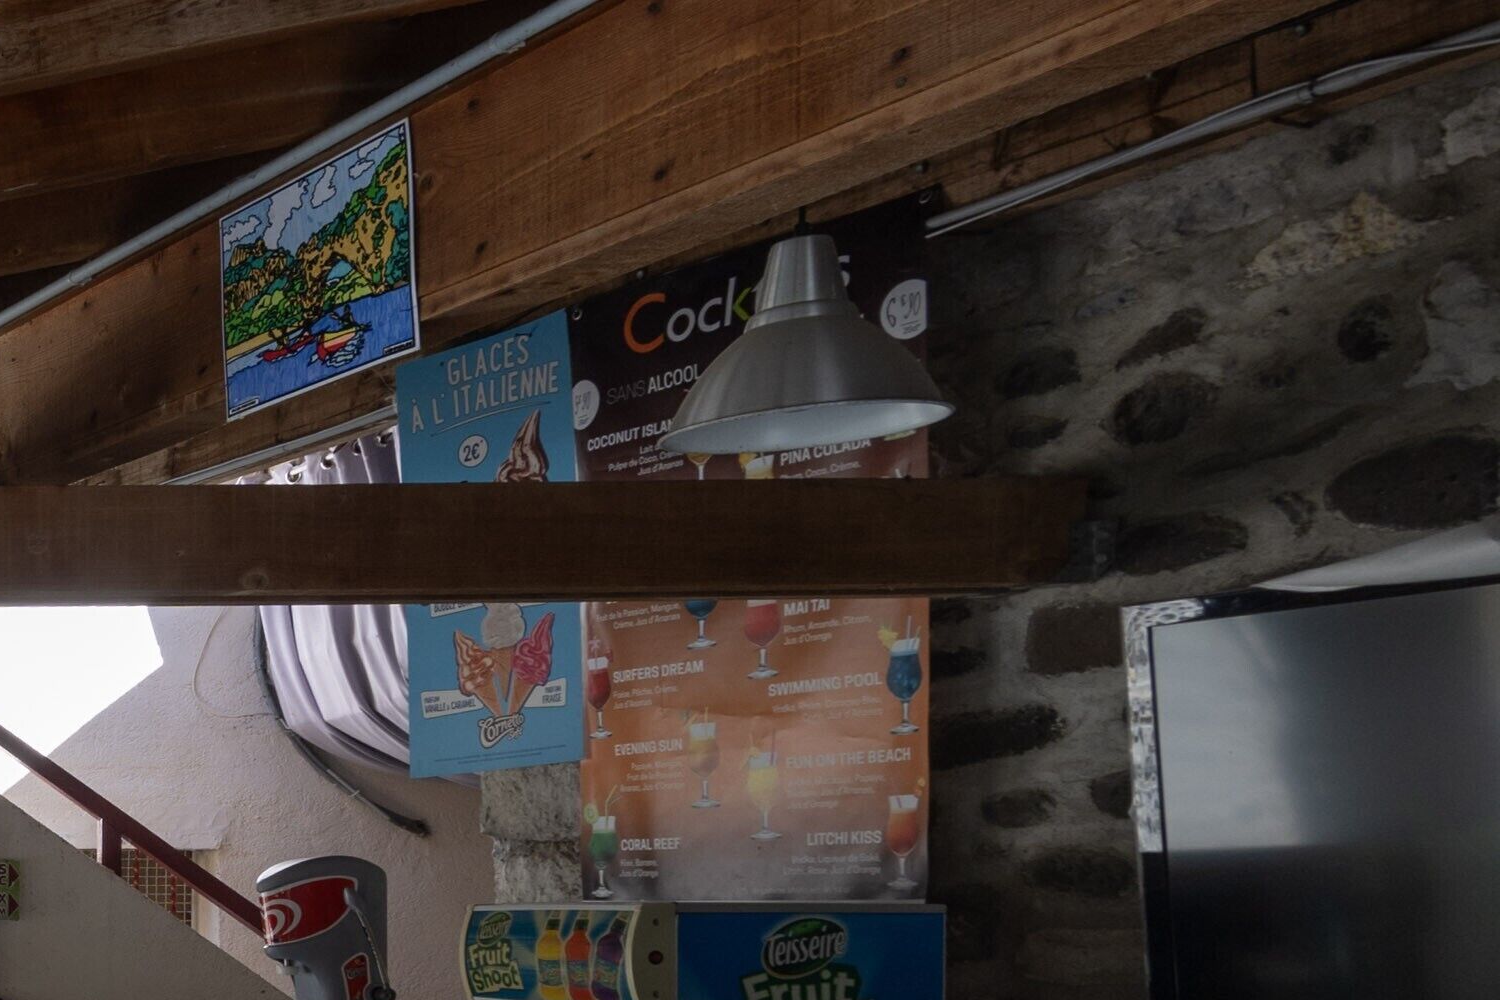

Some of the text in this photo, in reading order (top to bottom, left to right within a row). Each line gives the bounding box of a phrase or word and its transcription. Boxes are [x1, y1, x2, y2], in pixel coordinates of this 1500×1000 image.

[447, 334, 529, 386] GLACES
[606, 380, 646, 405] SANS
[647, 363, 701, 394] ALCOOL
[411, 399, 424, 434] À
[587, 427, 641, 452] COCONUT
[780, 449, 811, 467] PINA
[784, 599, 831, 617] MAI TAI
[613, 659, 704, 684] SURFERS DREAM
[768, 671, 883, 697] SWIMMING POOL
[479, 713, 524, 748] Cornetto
[614, 738, 683, 757] EVENING SUN
[839, 751, 865, 765] THE
[868, 747, 911, 764] BEACH
[620, 837, 681, 851] CORAL REEF
[807, 830, 882, 846] LITCHI KISS
[469, 942, 511, 968] Fruit
[765, 925, 845, 968] Teisseire
[472, 965, 519, 991] Shoot
